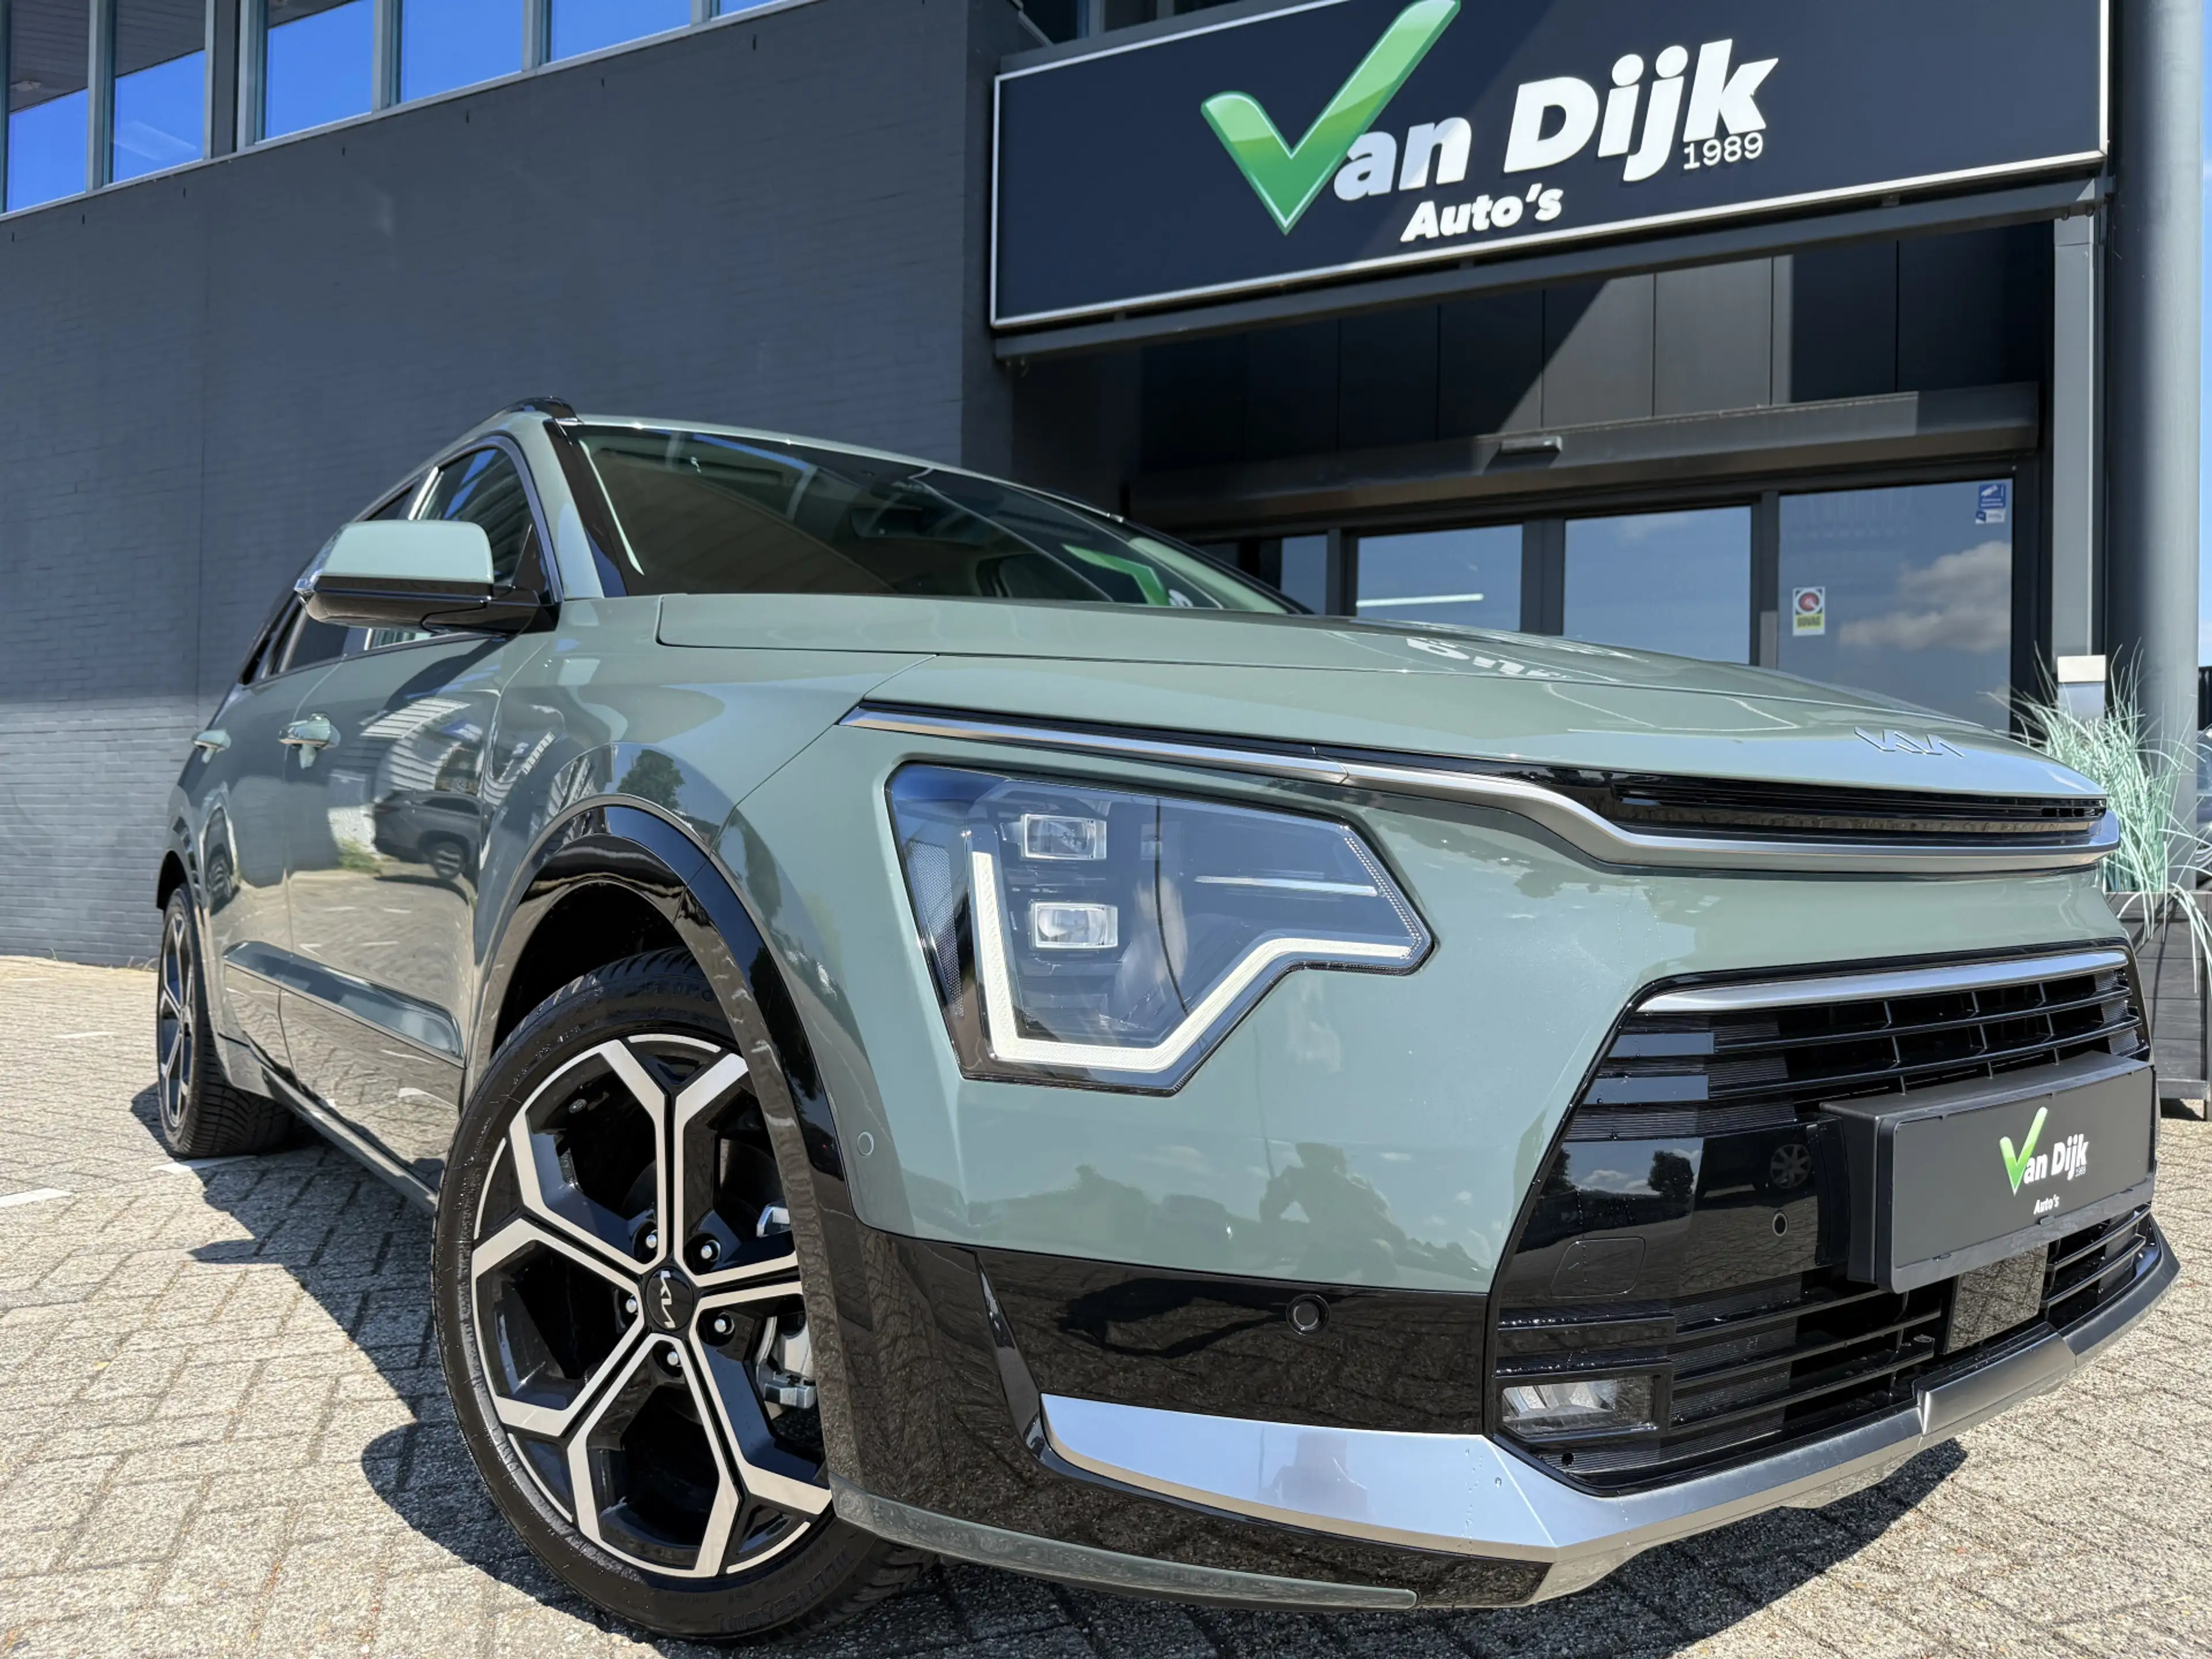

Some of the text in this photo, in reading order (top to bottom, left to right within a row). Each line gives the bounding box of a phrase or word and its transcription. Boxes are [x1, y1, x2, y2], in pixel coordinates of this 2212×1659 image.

[1503, 38, 1779, 181] Dijk
[1683, 132, 1764, 170] 1989
[1400, 183, 1564, 242] Auto's
[2050, 1133, 2089, 1181] Dijk
[2033, 1194, 2061, 1215] Auto's
